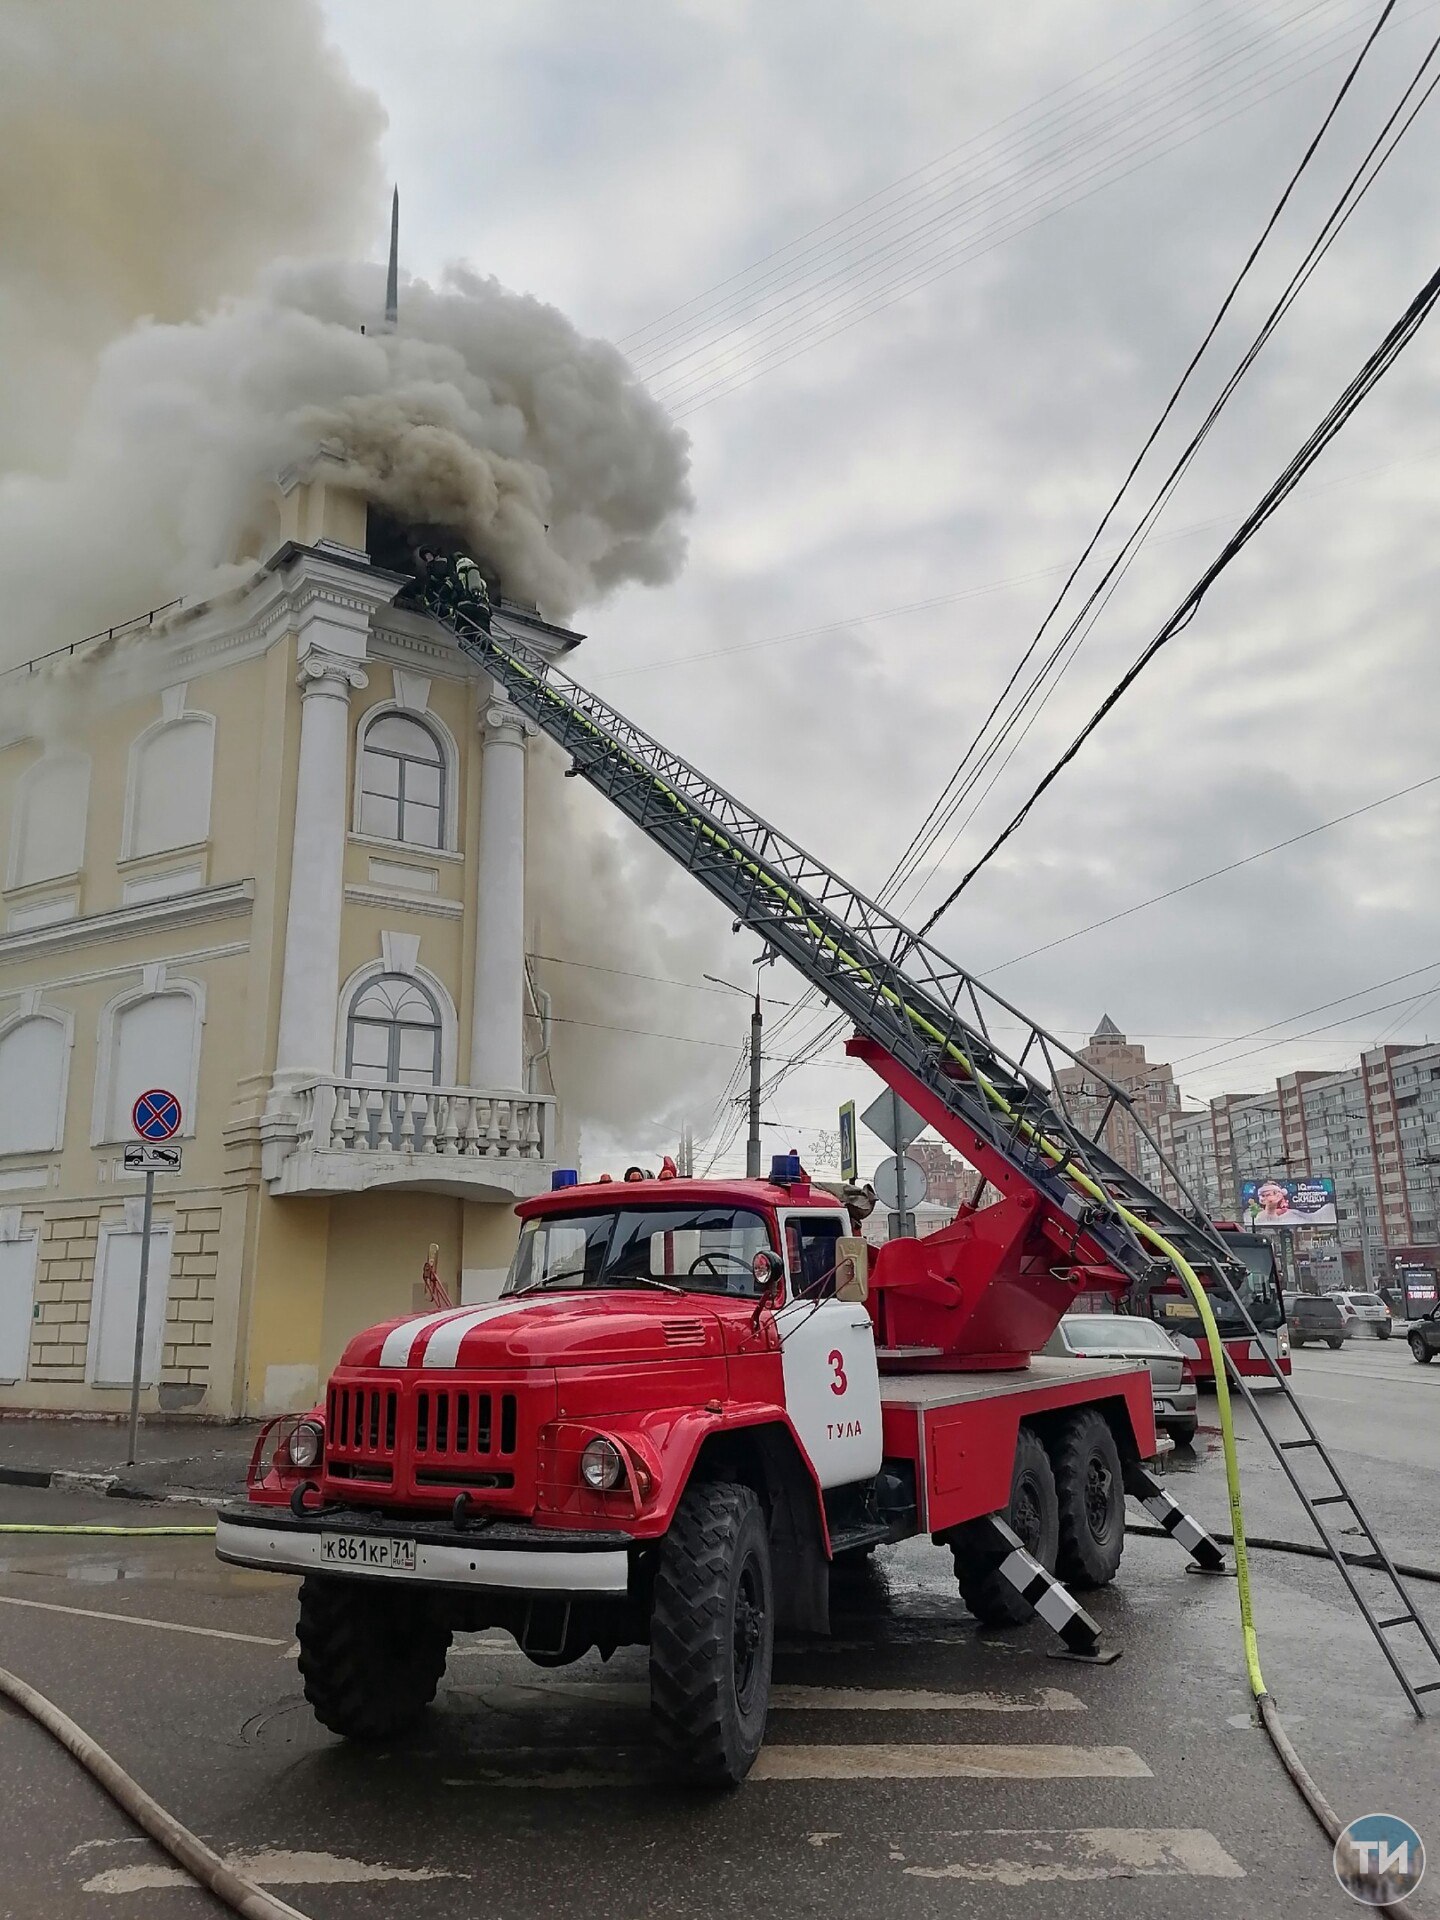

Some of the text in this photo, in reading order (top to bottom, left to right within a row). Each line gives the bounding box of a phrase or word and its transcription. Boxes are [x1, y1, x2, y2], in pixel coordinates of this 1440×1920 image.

[828, 1350, 848, 1395] 3
[827, 1420, 862, 1440] ТУЛА
[327, 1538, 409, 1563] К861КР 71
